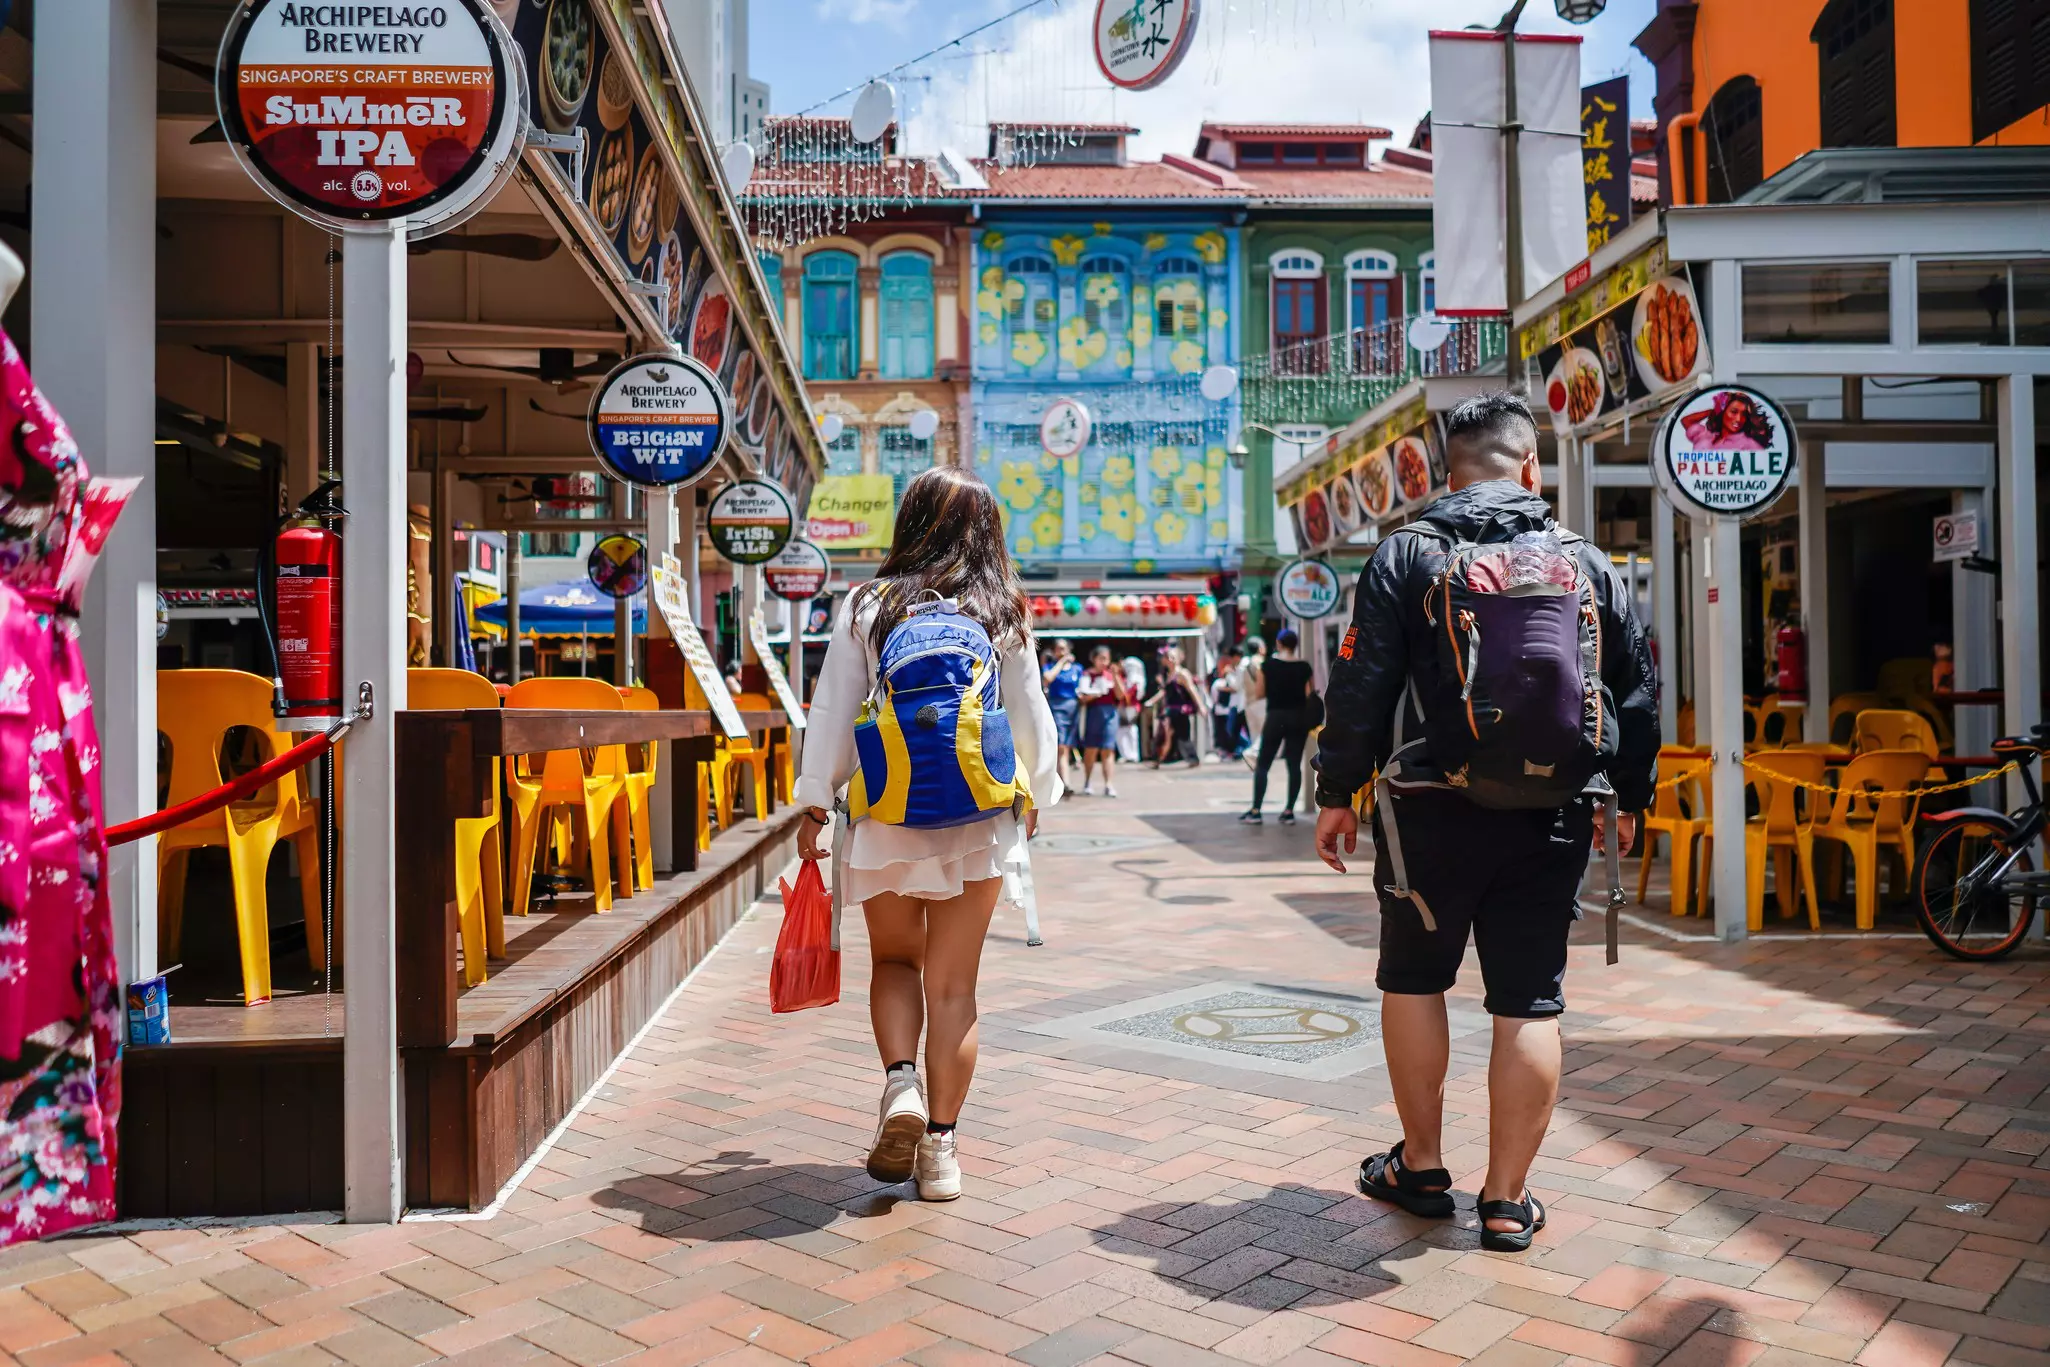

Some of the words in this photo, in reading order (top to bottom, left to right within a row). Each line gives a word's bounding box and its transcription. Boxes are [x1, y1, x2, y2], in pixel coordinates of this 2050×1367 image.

[279, 3, 447, 28] ARCHIPELAGO
[305, 29, 424, 54] BREWERY
[241, 70, 348, 84] SINGAPORE'S
[353, 70, 408, 84] CRAFT
[412, 71, 494, 85] BREWERY
[316, 130, 415, 166] IPA
[323, 180, 347, 192] alc.
[356, 179, 378, 193] 5.5%
[387, 179, 411, 192] vol.
[621, 384, 697, 396] ARCHIPELAGO
[632, 397, 687, 408] BREWERY
[1677, 452, 1726, 462] TROPICAL
[1677, 462, 1726, 475] PALE
[1729, 452, 1782, 475] ALE
[1694, 479, 1767, 491] ARCHIPELAGO
[724, 499, 776, 507] ARCHIPELAGO
[1705, 492, 1757, 503] BREWERY
[732, 507, 768, 515] BREWERY
[818, 497, 889, 514] Changer
